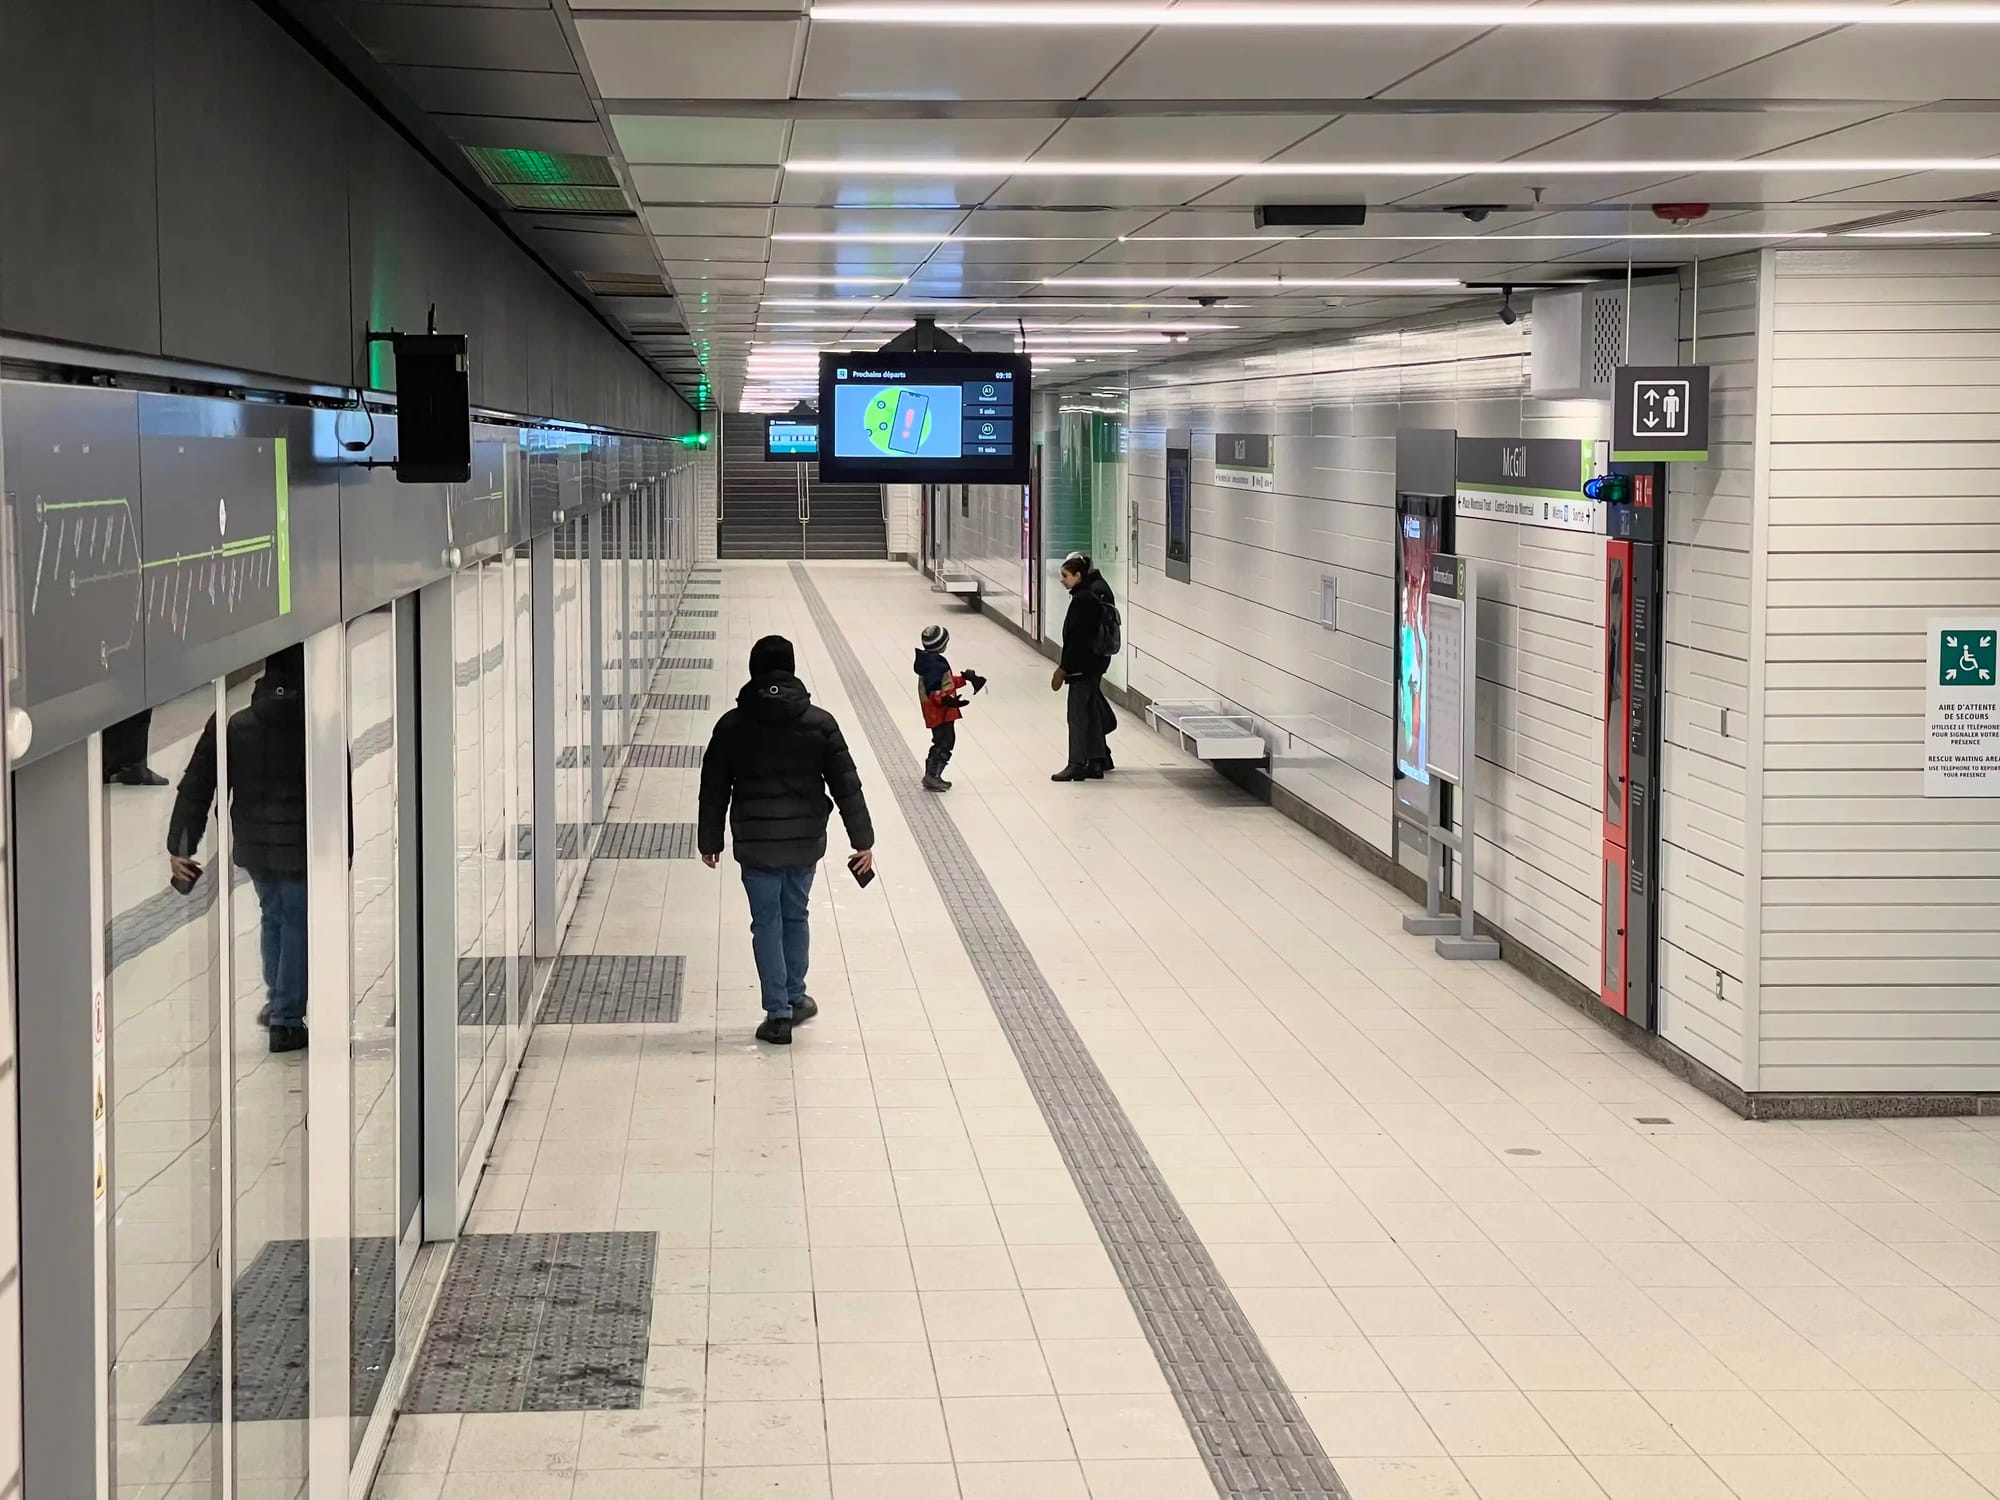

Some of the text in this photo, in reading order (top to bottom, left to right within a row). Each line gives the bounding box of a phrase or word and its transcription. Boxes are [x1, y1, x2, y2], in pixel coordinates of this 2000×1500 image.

[852, 370, 906, 379] Prochains départs
[1502, 446, 1527, 477] McGill
